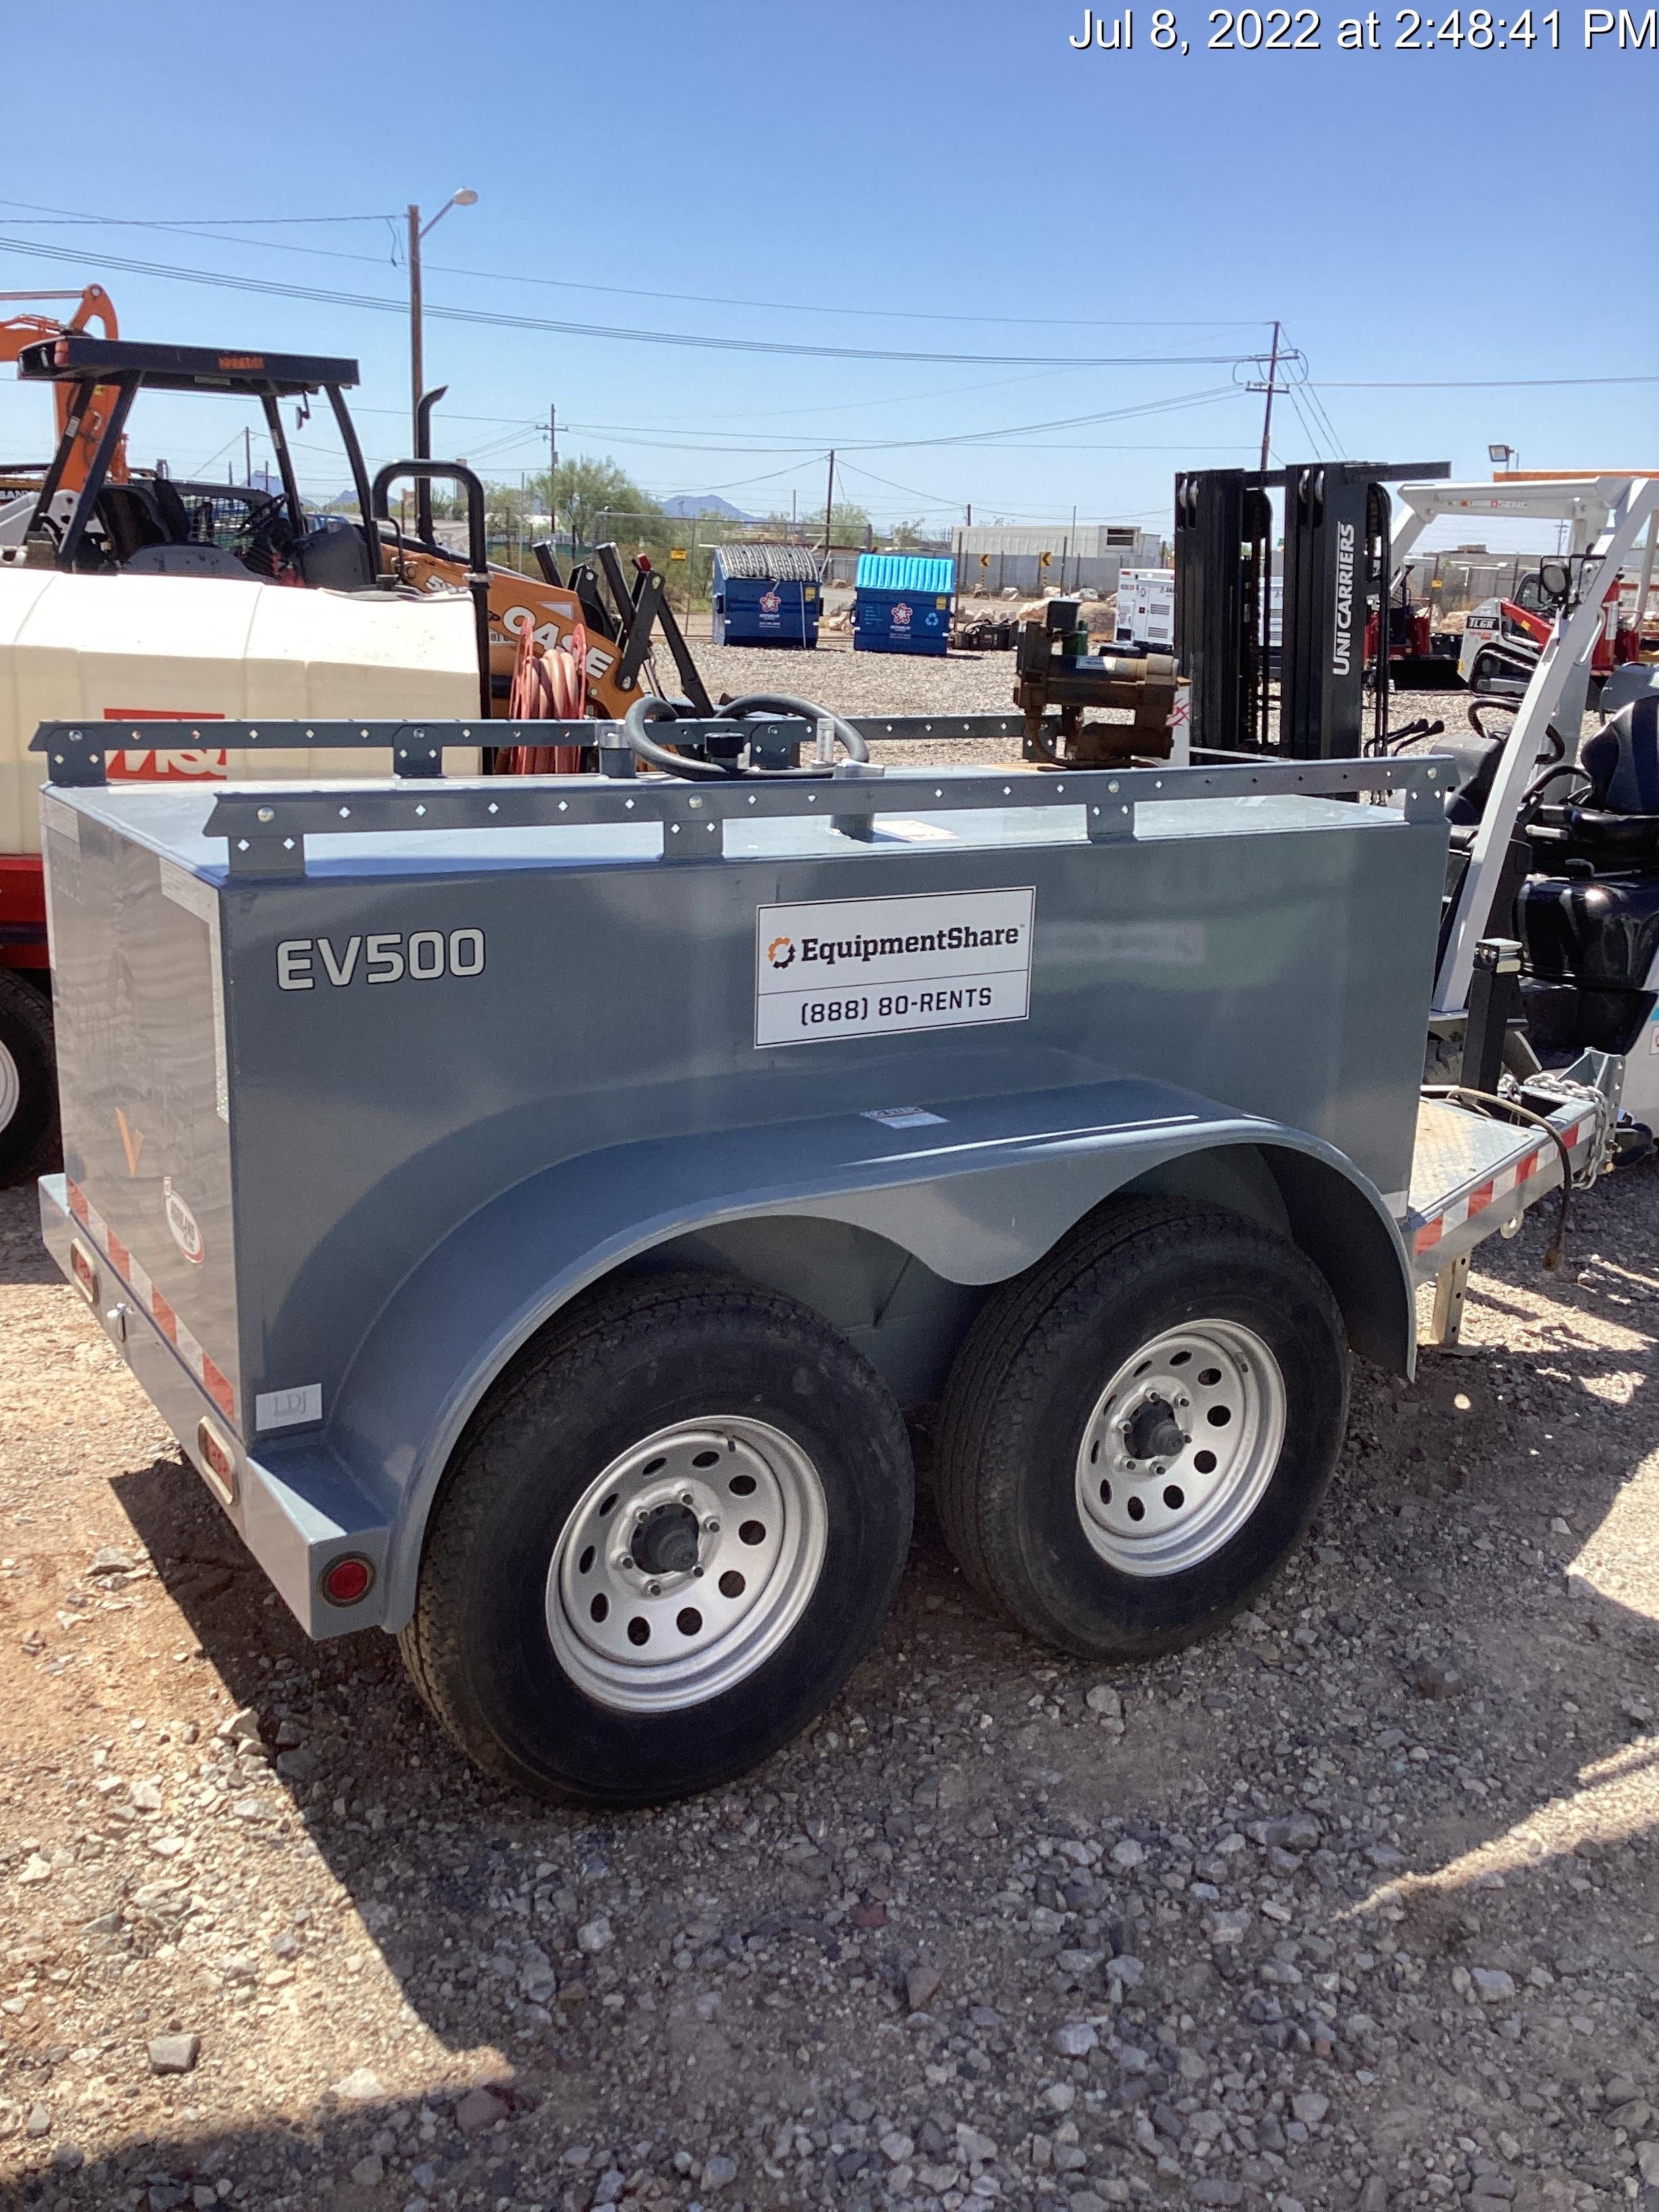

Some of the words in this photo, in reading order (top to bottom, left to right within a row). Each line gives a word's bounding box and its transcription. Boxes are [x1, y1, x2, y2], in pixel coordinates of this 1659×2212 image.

[1333, 521, 1355, 676] UNICARRIERS
[276, 927, 486, 991] EV500
[801, 926, 1019, 965] EquipmentShare
[801, 997, 868, 1025] (888)
[878, 987, 992, 1017] 80-RENTS
